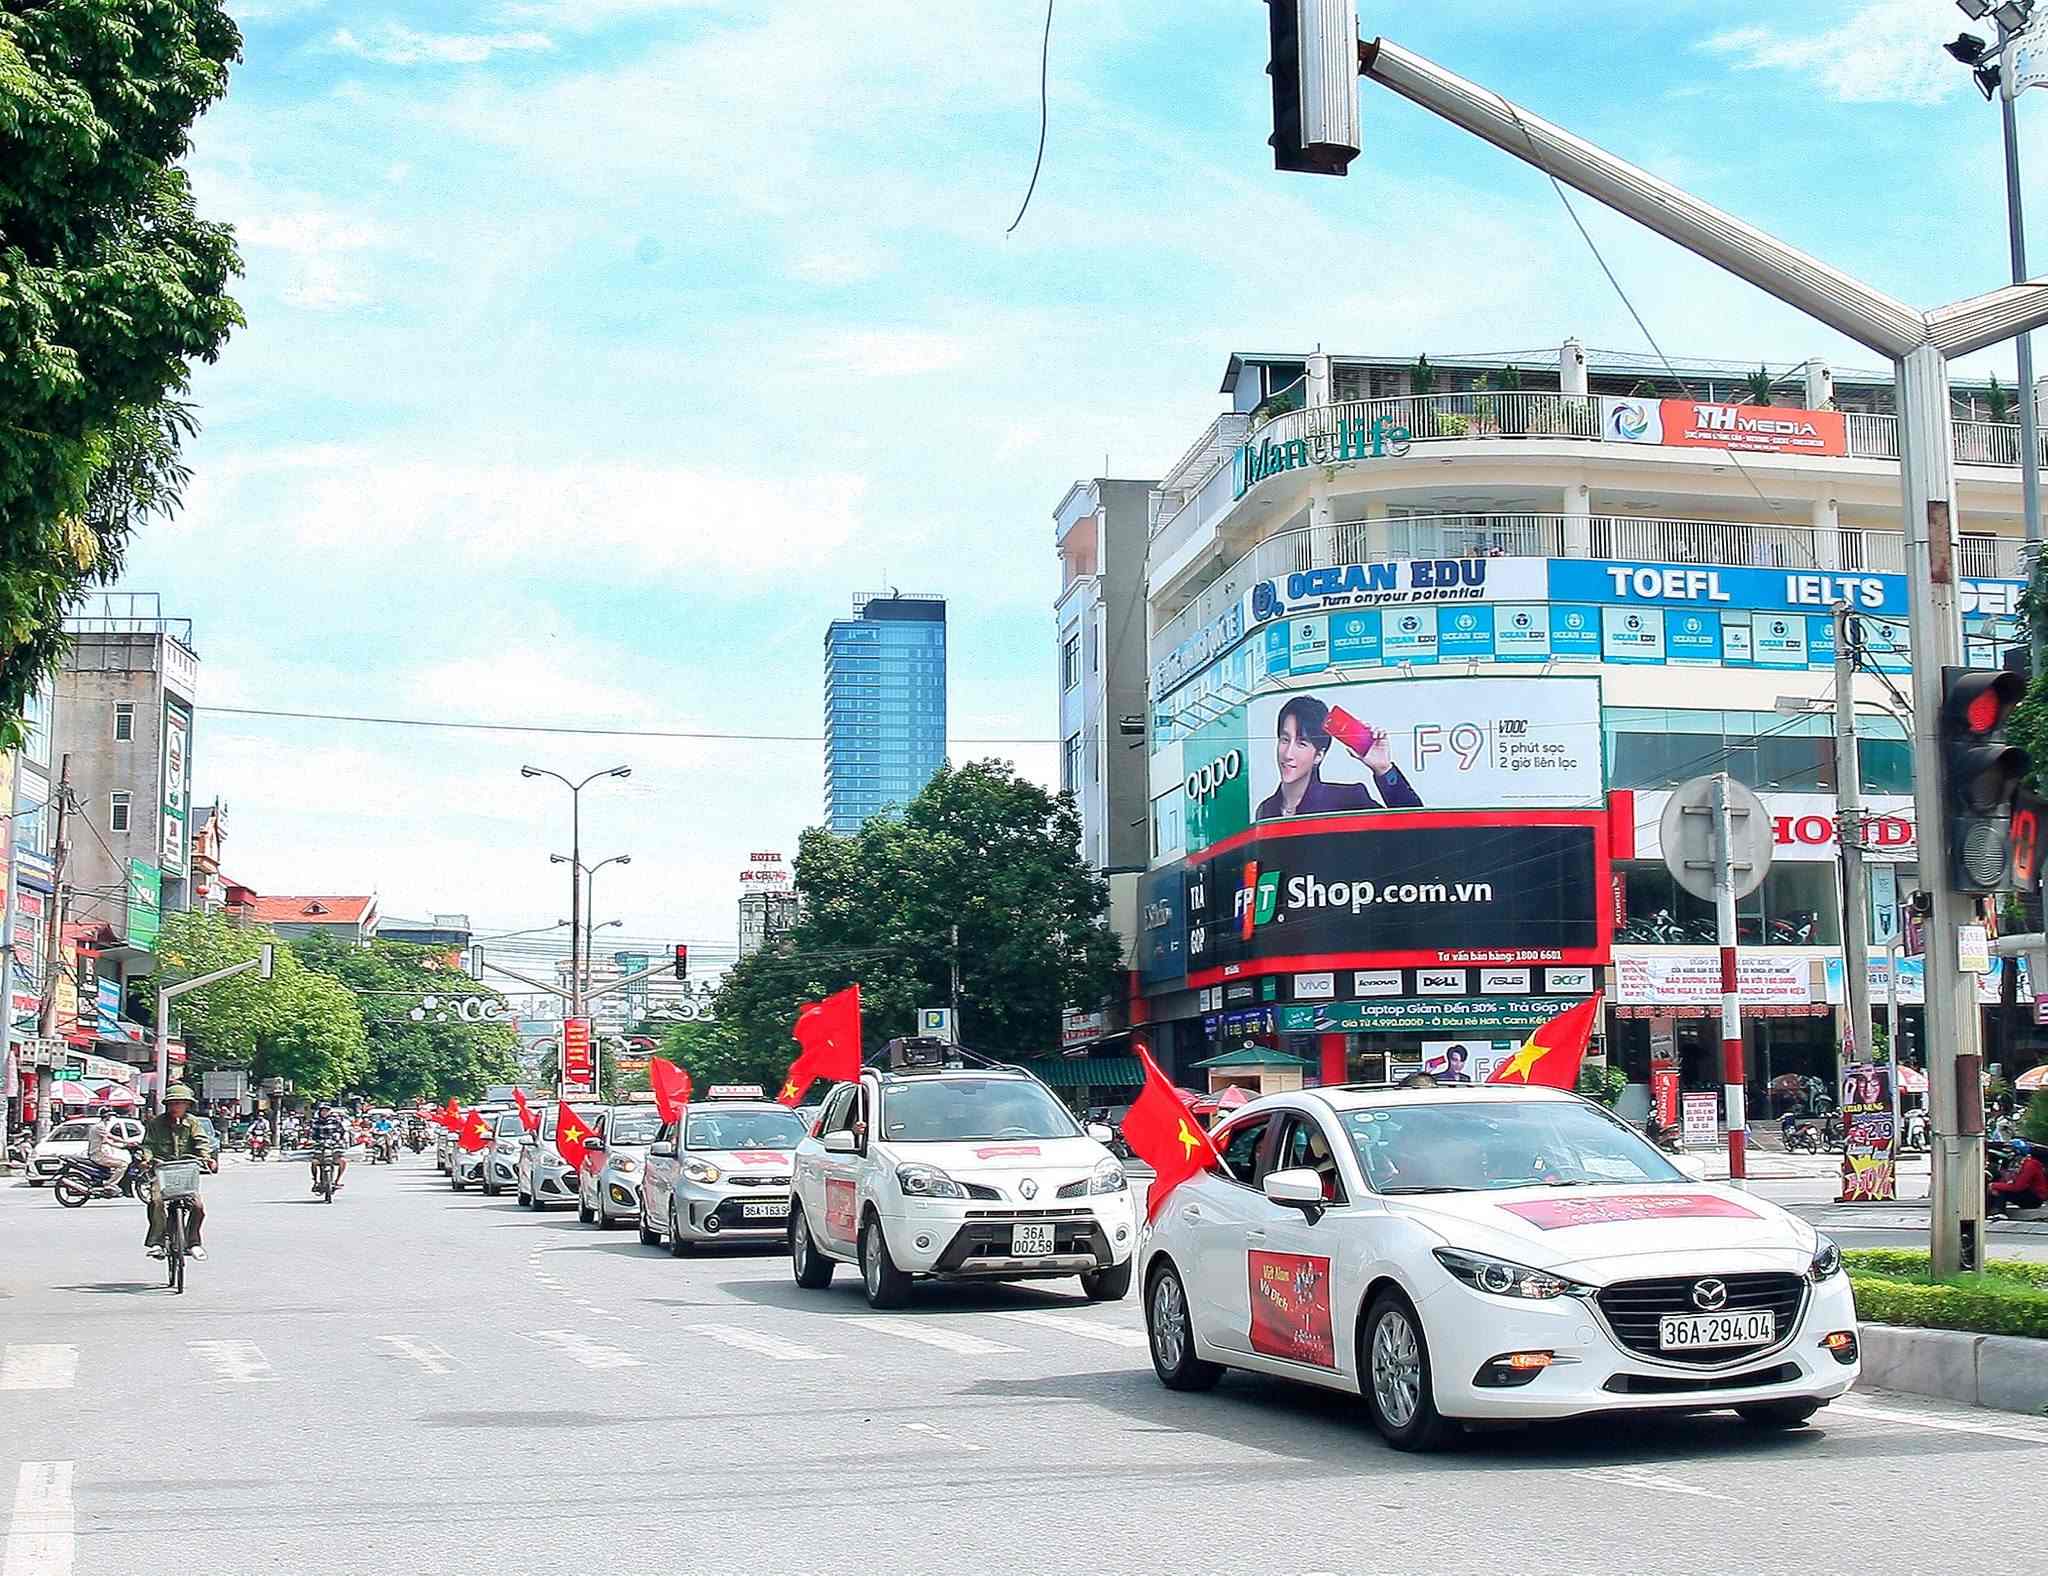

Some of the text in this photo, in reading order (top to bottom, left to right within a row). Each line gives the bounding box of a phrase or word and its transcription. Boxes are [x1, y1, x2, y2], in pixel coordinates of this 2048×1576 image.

[1287, 559, 1486, 599] OCEAN EDU
[1606, 566, 1884, 608] TOEFL IELTS
[1411, 586, 1484, 602] potential
[1413, 722, 1484, 772] F9
[1499, 742, 1508, 753] 5
[1499, 757, 1508, 768] 2
[1287, 874, 1493, 914] Shop.com.vn
[1516, 950, 1539, 961] 1800
[1361, 1005, 1405, 1017] Laptop
[1471, 1003, 1498, 1014] 30%
[1023, 1226, 1045, 1240] 36A
[1664, 1316, 1770, 1345] 36A-294.04
